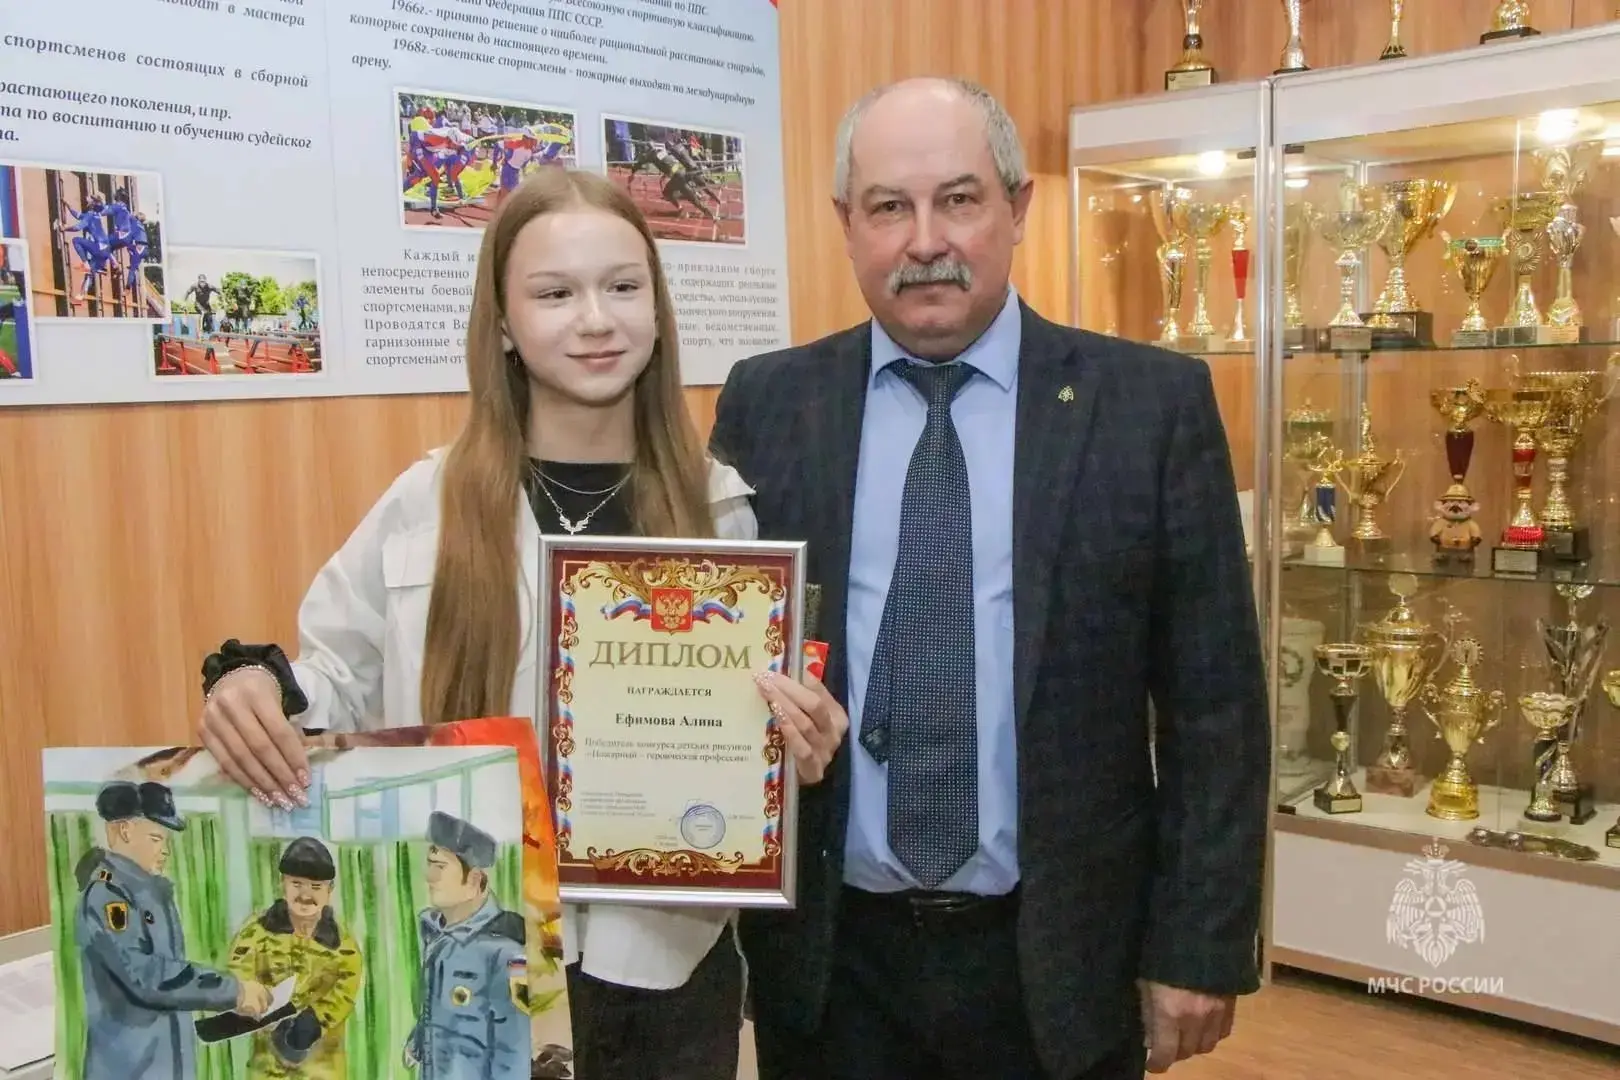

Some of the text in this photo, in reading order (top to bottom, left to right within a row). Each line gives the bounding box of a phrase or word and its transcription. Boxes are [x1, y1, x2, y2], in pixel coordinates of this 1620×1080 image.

[227, 4, 235, 14] в
[243, 8, 305, 27] мастера
[436, 8, 489, 25] принято
[492, 17, 539, 35] решение
[541, 27, 548, 36] о
[548, 8, 572, 22] ППС
[574, 13, 604, 28] СССР.
[350, 13, 608, 64] которые сохранены до настоящего времени.
[4, 34, 309, 88] спортсменов состоящих в сборной
[351, 54, 392, 70] арену.
[498, 55, 567, 75] спортсмены
[576, 67, 628, 85] пожарные
[629, 76, 671, 91] выходят
[110, 95, 196, 117] поколения,
[199, 105, 207, 116] и
[210, 107, 232, 121] пр.
[27, 108, 47, 121] по
[52, 111, 157, 133] воспитанию
[160, 123, 169, 134] и
[174, 123, 244, 142] обучению
[248, 131, 311, 149] судейског
[404, 249, 460, 262] Каждый
[361, 267, 470, 280] непосредственно
[363, 286, 424, 296] элементы
[363, 302, 457, 315] спортсменами,
[365, 319, 446, 332] Проводятся
[366, 338, 450, 350] гарнизонные
[366, 354, 448, 367] спортсменам
[588, 640, 752, 670] ДИПЛОМ
[627, 686, 712, 697] НАГРАЖДАЕТСЯ
[615, 712, 723, 728] Ефимова Алина
